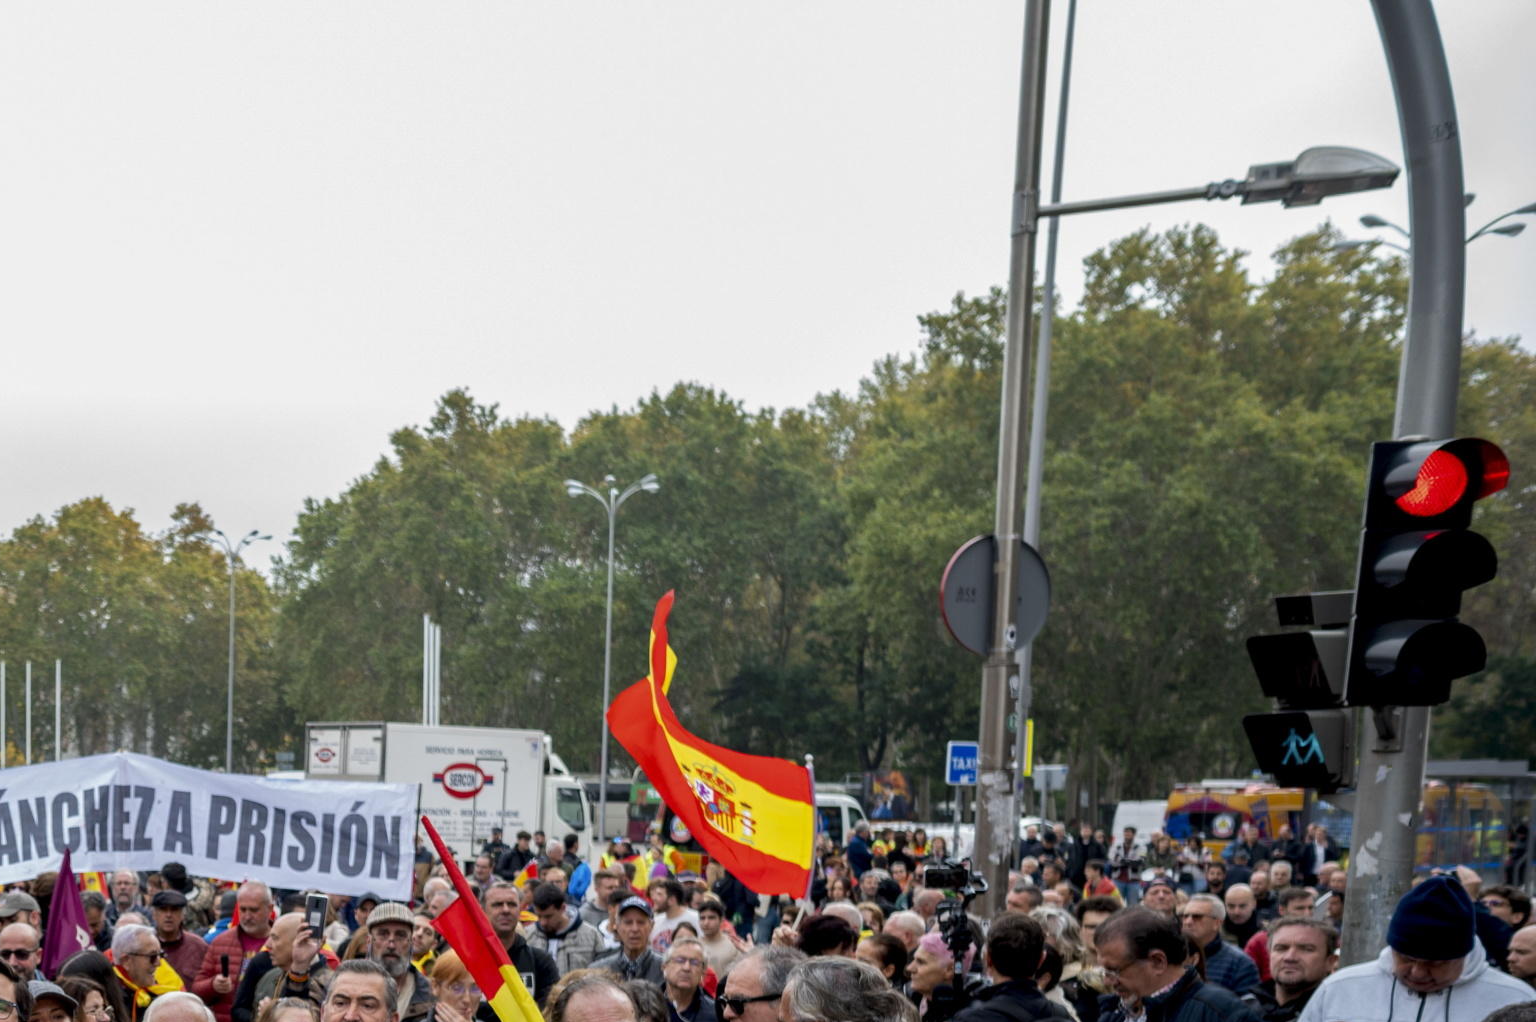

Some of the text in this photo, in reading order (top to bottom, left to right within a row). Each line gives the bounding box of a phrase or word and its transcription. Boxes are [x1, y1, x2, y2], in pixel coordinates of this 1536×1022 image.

[951, 756, 977, 770] TAXI
[163, 790, 194, 856] A
[205, 793, 402, 881] PRISIÓN
